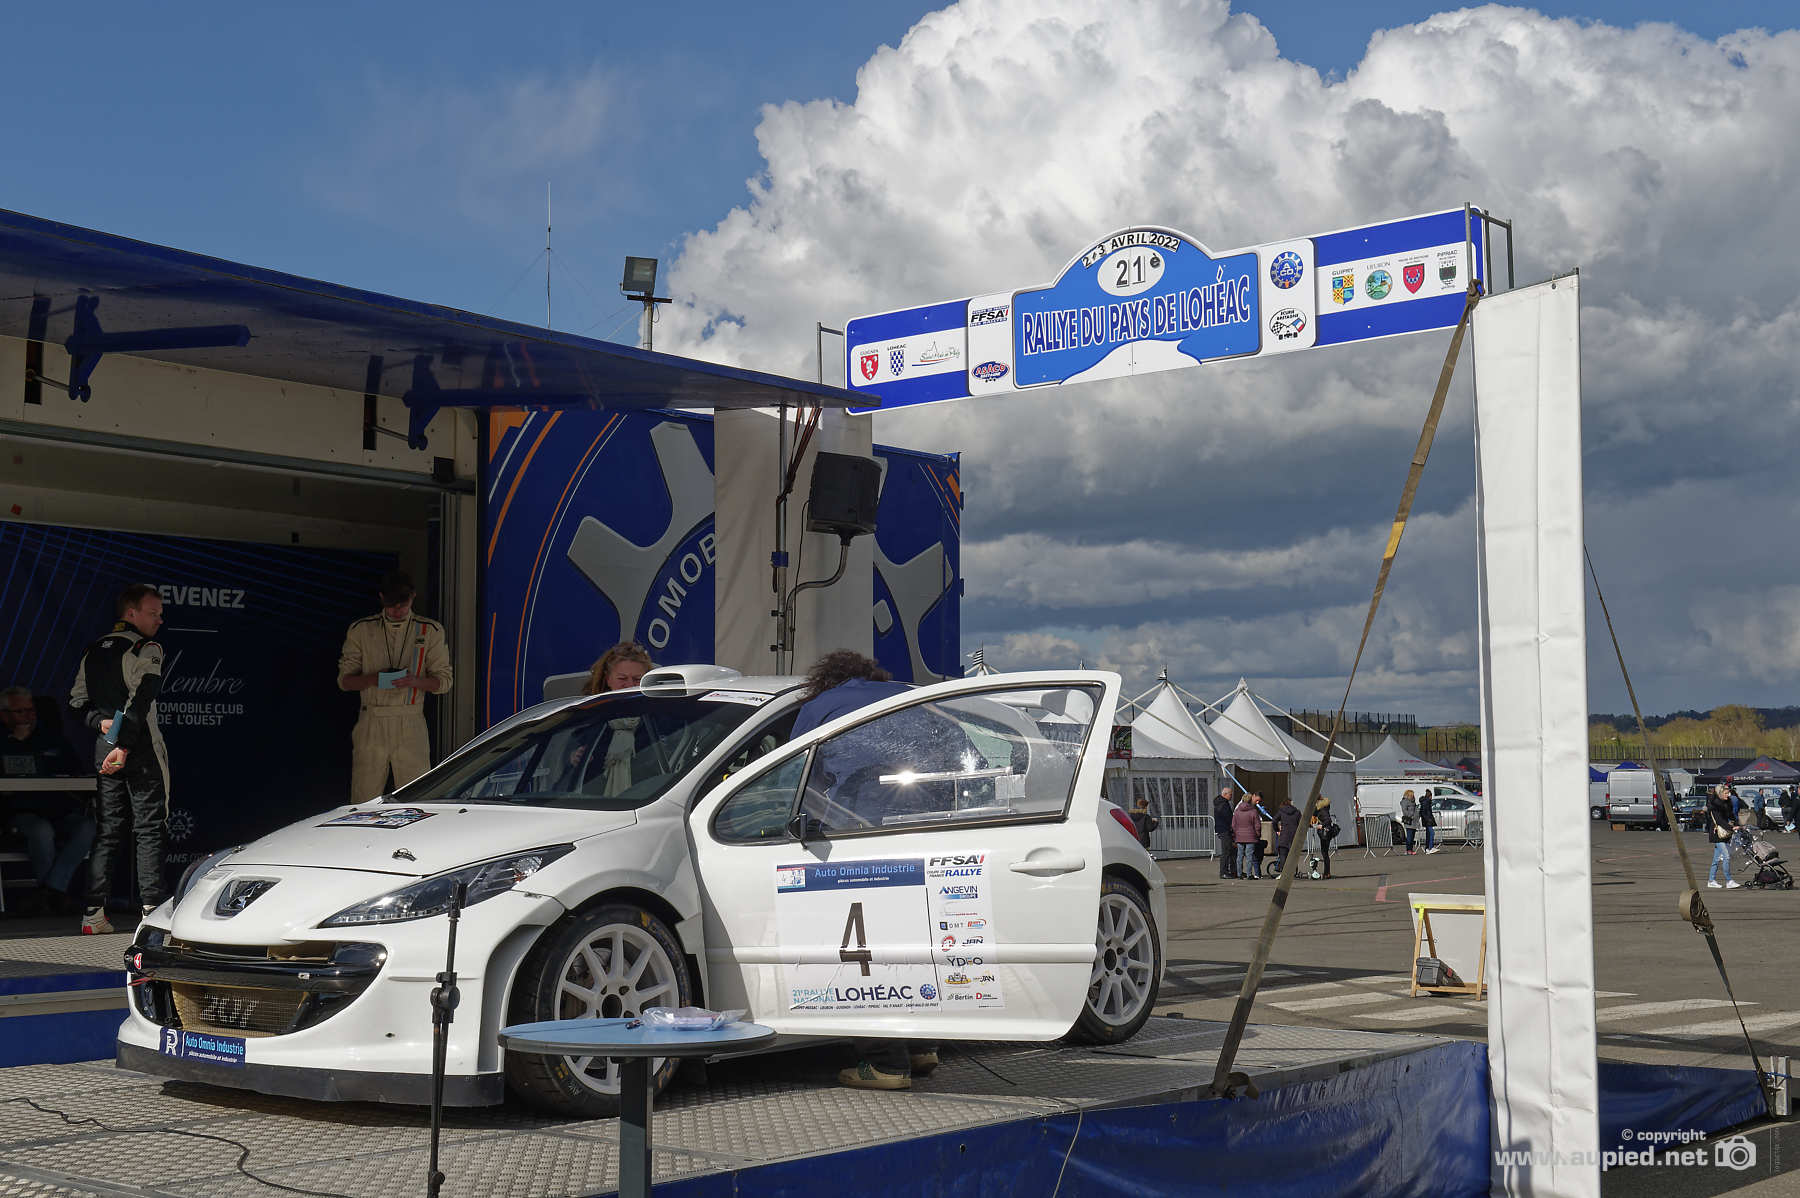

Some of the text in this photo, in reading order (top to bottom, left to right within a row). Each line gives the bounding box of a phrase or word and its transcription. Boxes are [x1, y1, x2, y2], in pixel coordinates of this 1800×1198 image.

[1111, 232, 1147, 250] AVRIL
[1149, 232, 1179, 251] 2022
[971, 310, 1006, 322] FFSA
[1023, 264, 1251, 355] RALLYE DU PAYS DE LOHÉAC
[214, 703, 244, 715] CLUB
[156, 713, 224, 726] DE L'OUEST
[930, 854, 979, 867] FFSA
[815, 862, 915, 878] Auto Omnia Industrie
[945, 868, 982, 877] RALLYE
[939, 885, 978, 895] ANGEVIN
[839, 902, 873, 977] 4
[835, 984, 914, 1002] LOHÉAC
[186, 1034, 244, 1055] Auto Omnia Industrie
